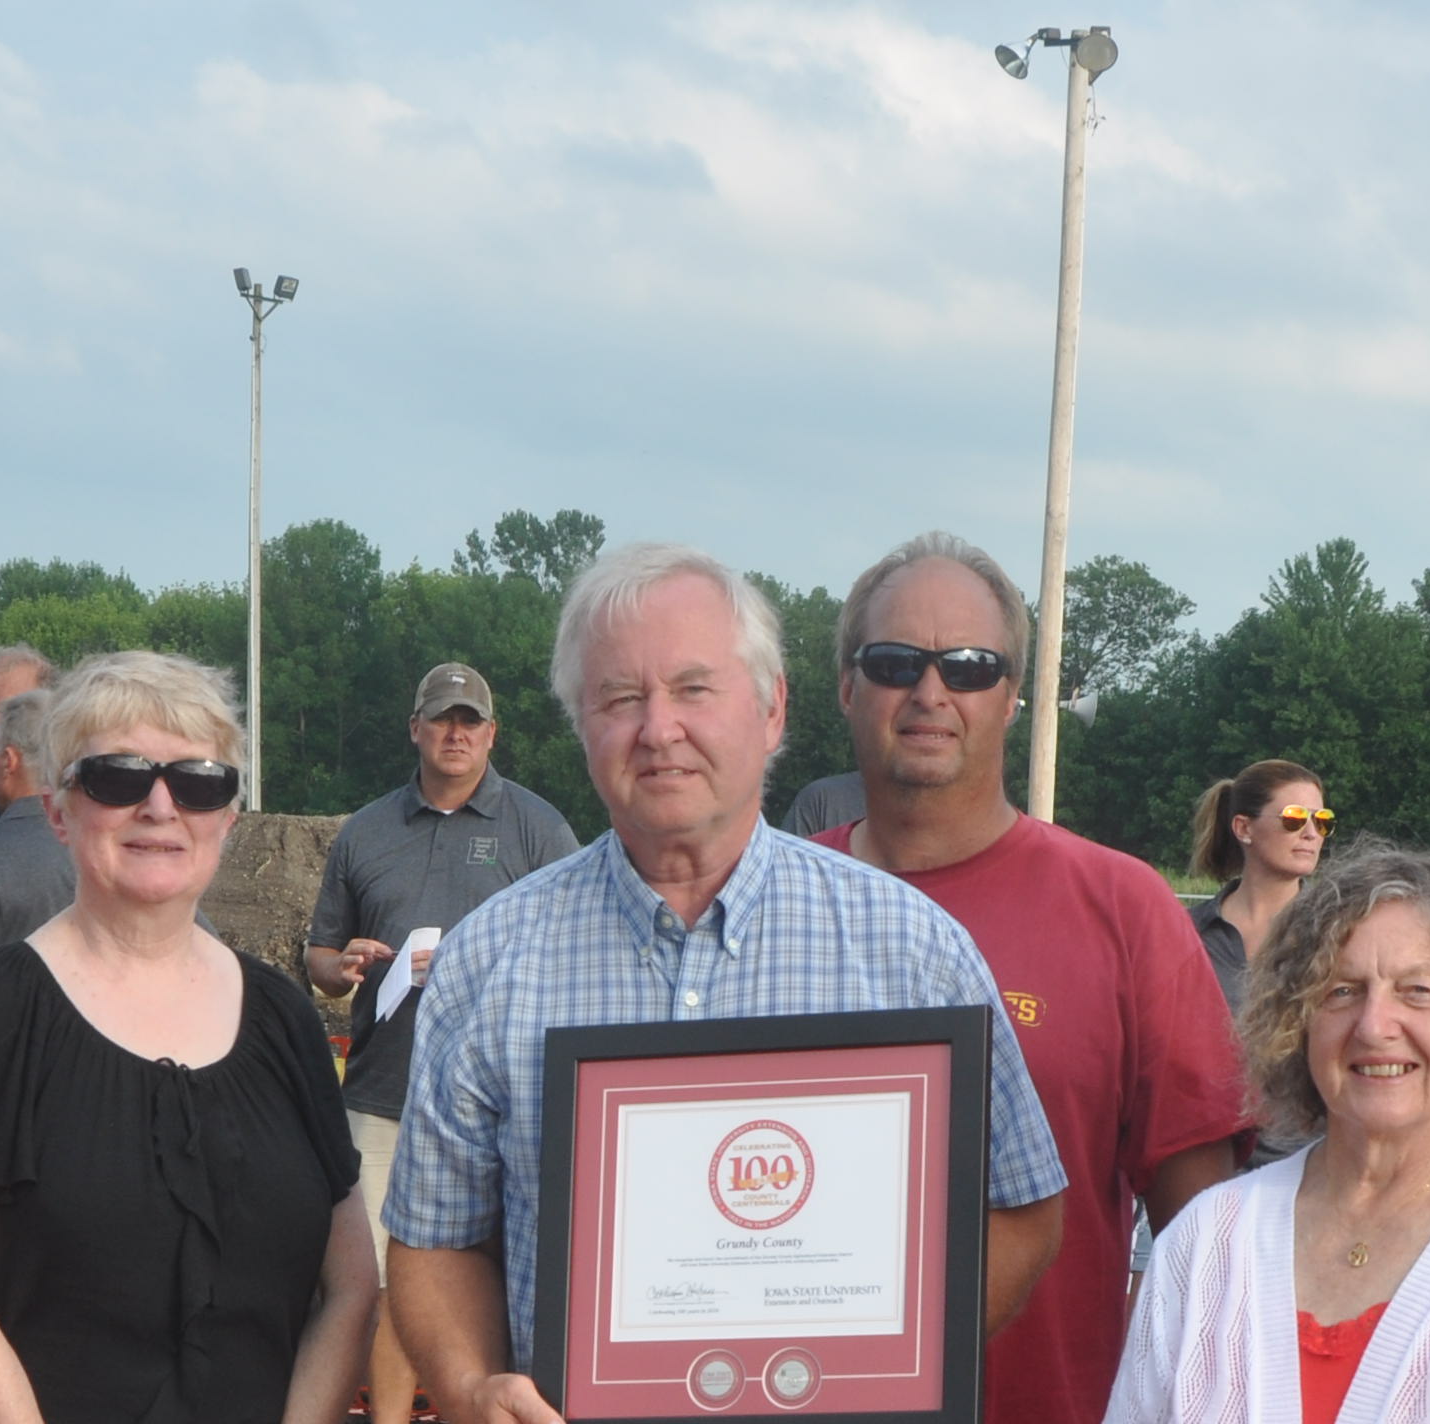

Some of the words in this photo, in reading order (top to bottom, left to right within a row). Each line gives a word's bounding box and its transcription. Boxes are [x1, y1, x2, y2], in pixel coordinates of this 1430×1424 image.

[727, 1154, 795, 1191] 100
[715, 1237, 760, 1250] Grundy
[762, 1236, 804, 1249] County
[764, 1287, 791, 1298] IOWA
[792, 1286, 823, 1297] STATE
[824, 1284, 883, 1296] UNIVERSITY
